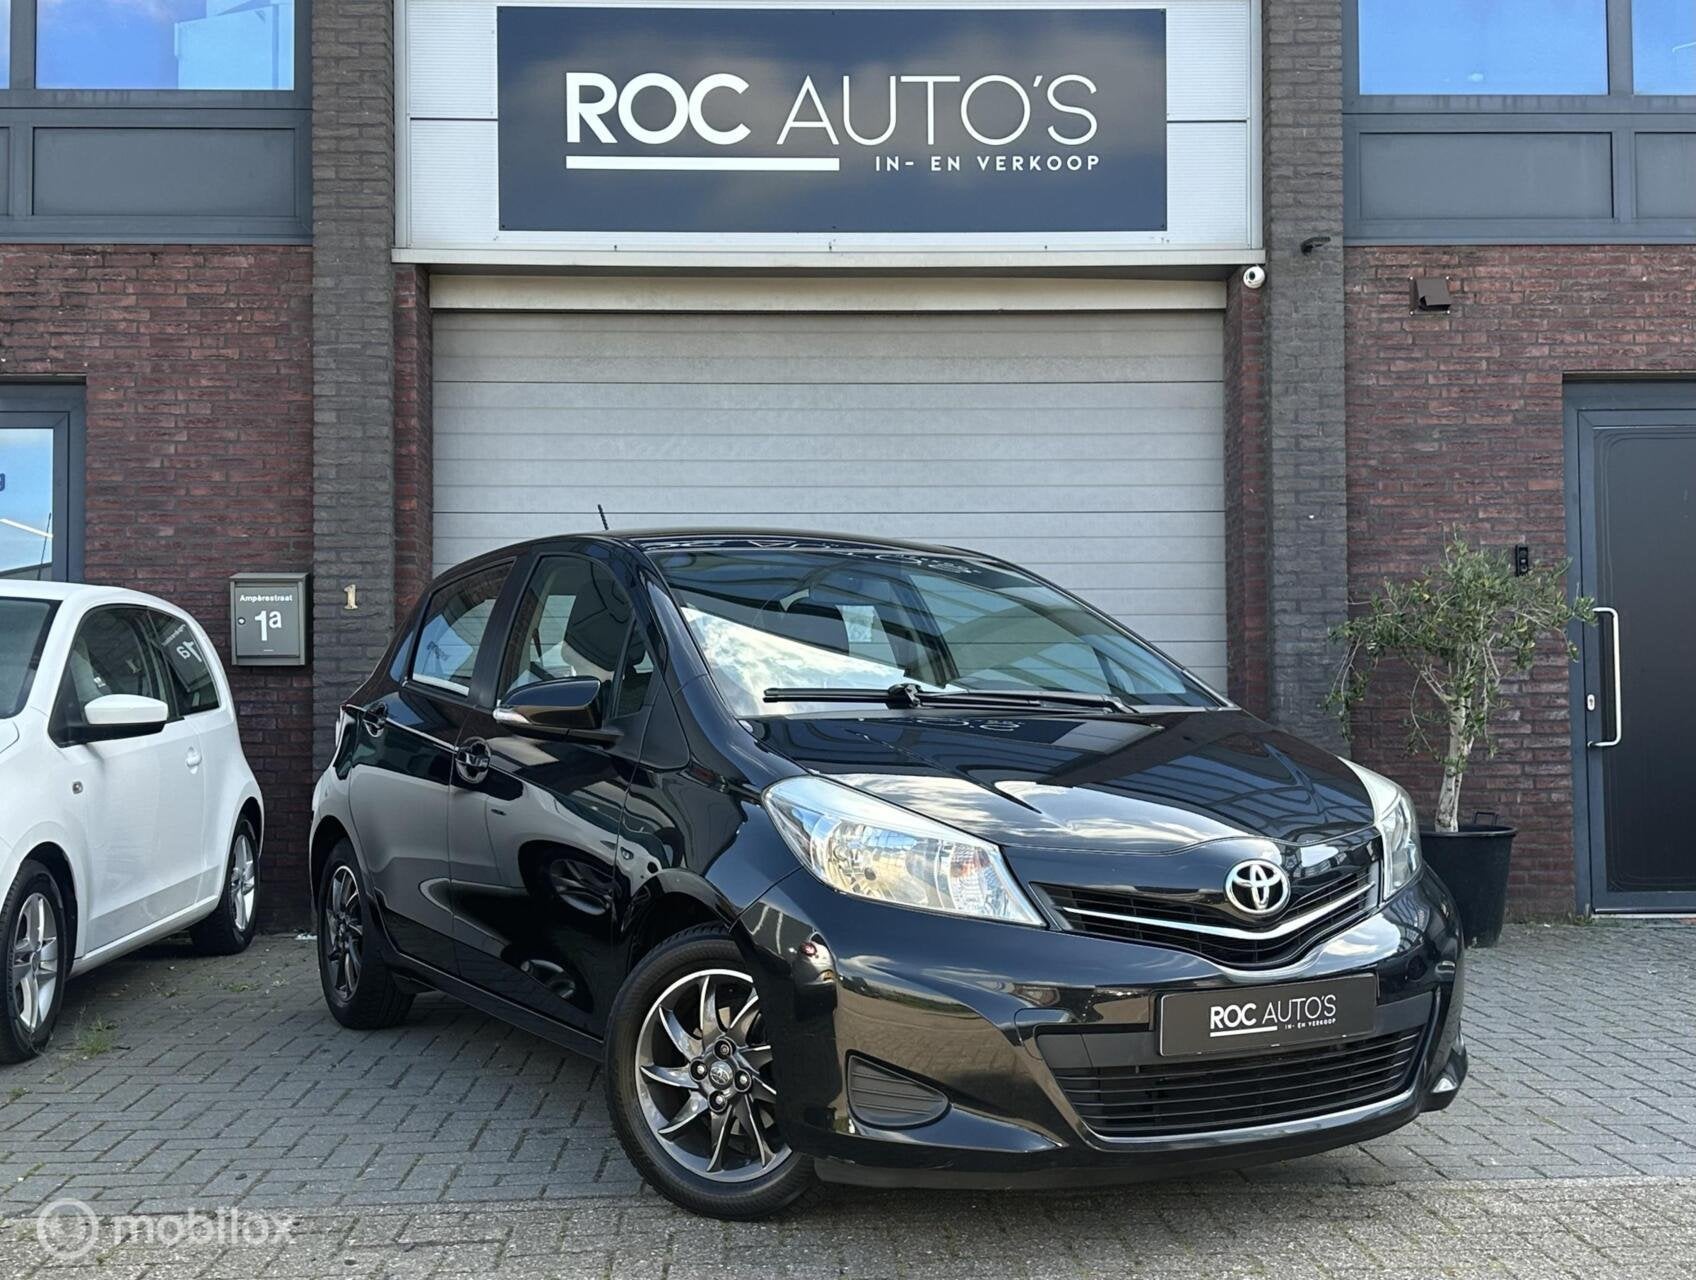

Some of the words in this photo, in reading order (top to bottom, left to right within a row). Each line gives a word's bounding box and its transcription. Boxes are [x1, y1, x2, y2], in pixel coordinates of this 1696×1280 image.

[565, 72, 750, 145] ROC
[776, 74, 1098, 147] AUTO'S
[875, 156, 914, 171] IN-
[931, 156, 961, 171] EN
[977, 155, 1100, 171] VERKOOP
[343, 584, 358, 610] 1
[254, 610, 282, 641] 1a
[1210, 1003, 1257, 1030] ROC
[1262, 994, 1337, 1024] AUTO'S
